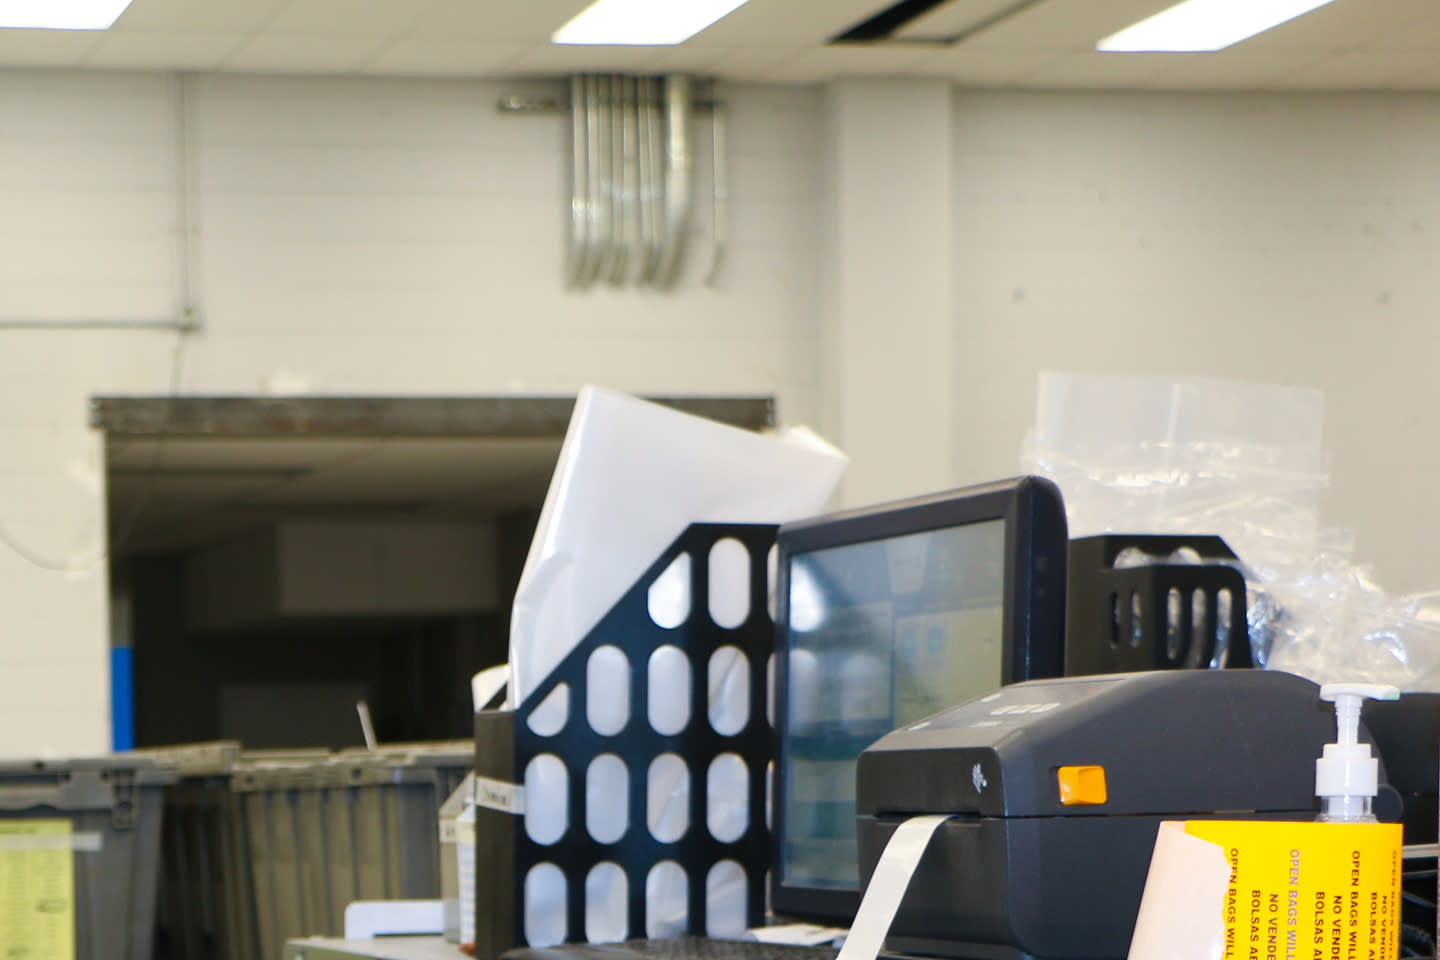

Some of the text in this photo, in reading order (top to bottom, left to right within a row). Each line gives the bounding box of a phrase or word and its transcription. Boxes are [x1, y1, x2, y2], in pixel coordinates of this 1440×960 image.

[1229, 848, 1238, 883] OPEN
[1289, 849, 1300, 885] OPEN
[1352, 851, 1360, 886] OPEN
[1228, 889, 1236, 923] BAGS
[1250, 890, 1260, 942] BOLSAS
[1269, 894, 1278, 912] NO
[1288, 891, 1298, 925] BAGS
[1314, 892, 1324, 943] BOLSAS
[1333, 895, 1341, 914] NO
[1349, 892, 1358, 926] BAGS
[1369, 892, 1377, 944] BOLSAS
[1381, 896, 1387, 914] NO
[1226, 928, 1235, 959] WILL
[1286, 930, 1296, 960] WILL
